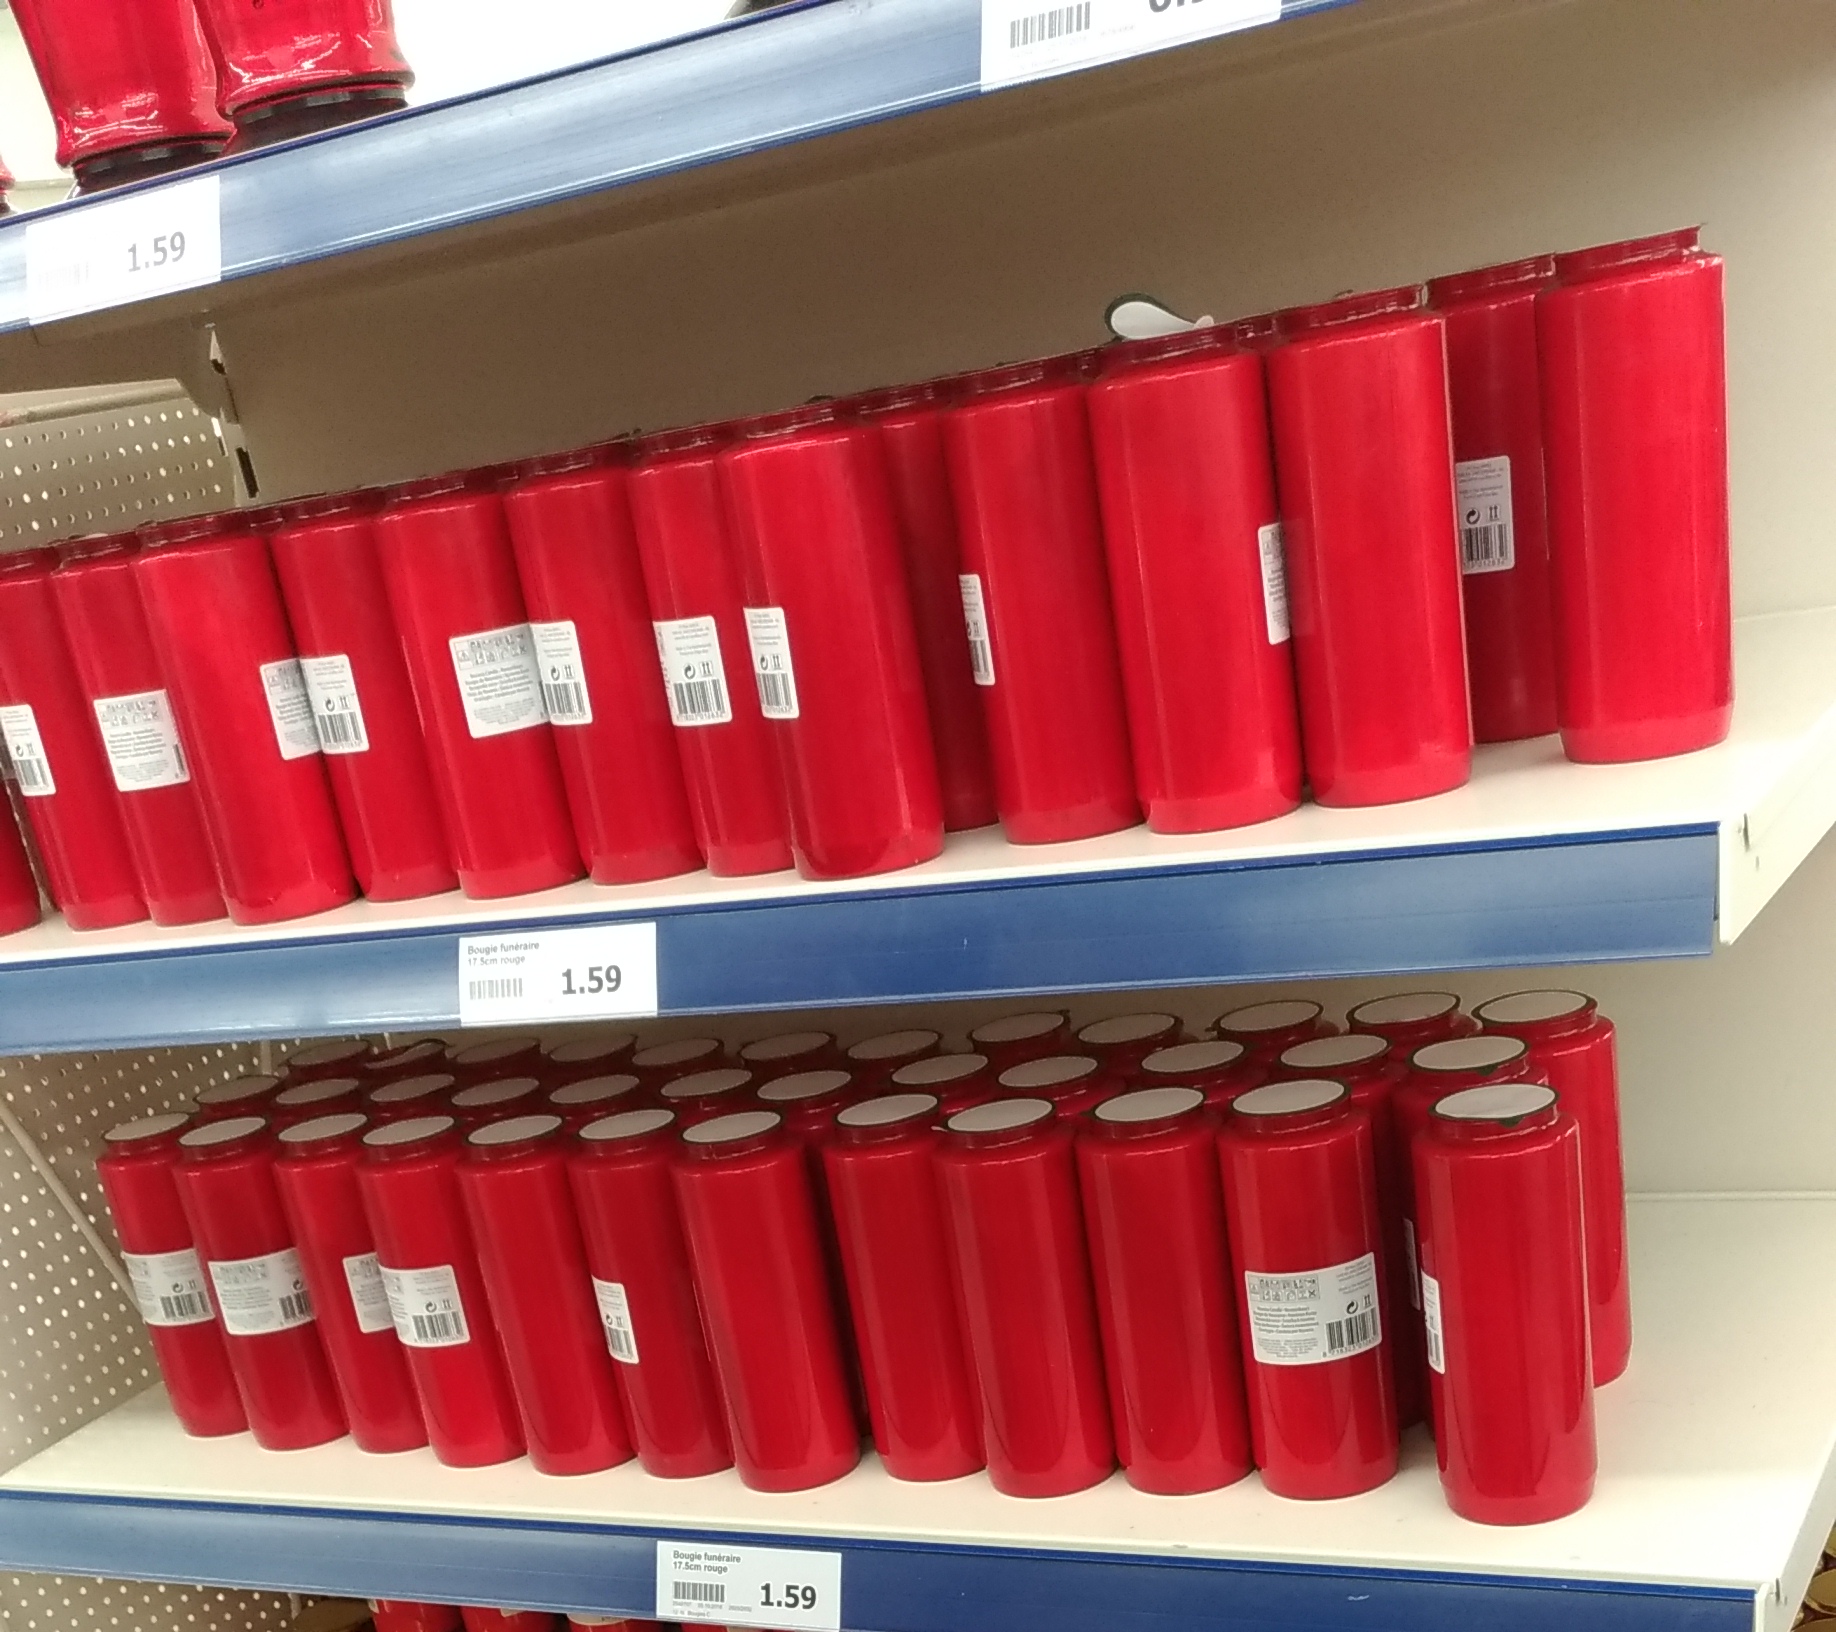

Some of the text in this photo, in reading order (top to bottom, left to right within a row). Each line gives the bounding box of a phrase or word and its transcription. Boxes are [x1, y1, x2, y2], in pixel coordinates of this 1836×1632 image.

[127, 231, 186, 272] 1.59
[467, 941, 540, 956] Bougie funéraire
[501, 955, 526, 965] rouge
[561, 964, 622, 995] 1.59
[673, 1550, 741, 1563] Bougie funéraire
[673, 1561, 728, 1574] 17.5cm rouge
[760, 1583, 817, 1610] 1.59
